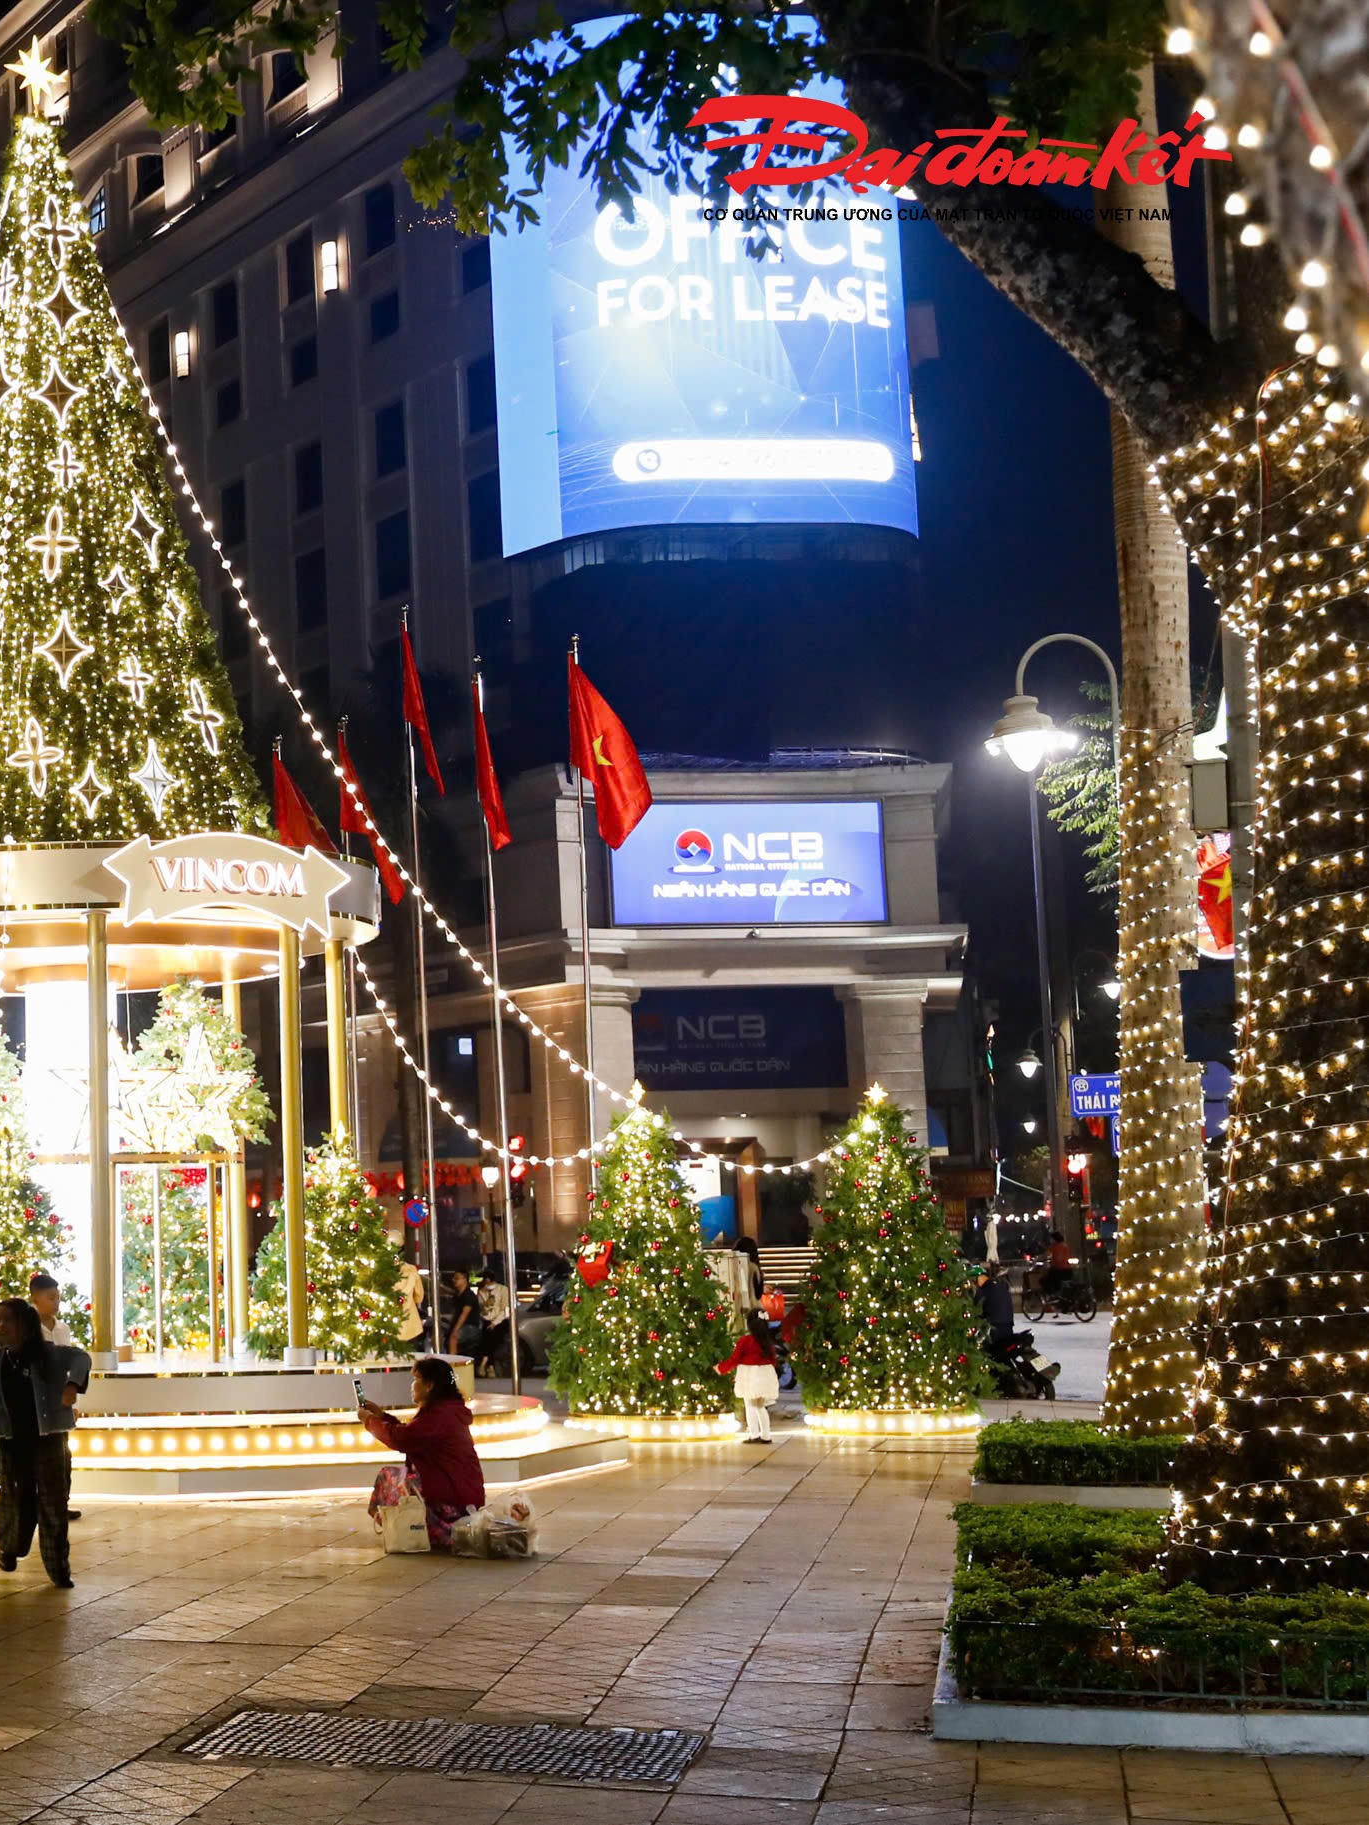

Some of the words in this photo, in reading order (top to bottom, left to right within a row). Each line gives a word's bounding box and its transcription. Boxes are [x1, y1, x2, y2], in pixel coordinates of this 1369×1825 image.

[596, 273, 716, 327] FOR
[732, 275, 891, 328] LEASE
[722, 832, 824, 861] NCB
[150, 856, 308, 897] VINCOM
[677, 1015, 767, 1041] NCB
[1076, 1091, 1107, 1110] THÁI
